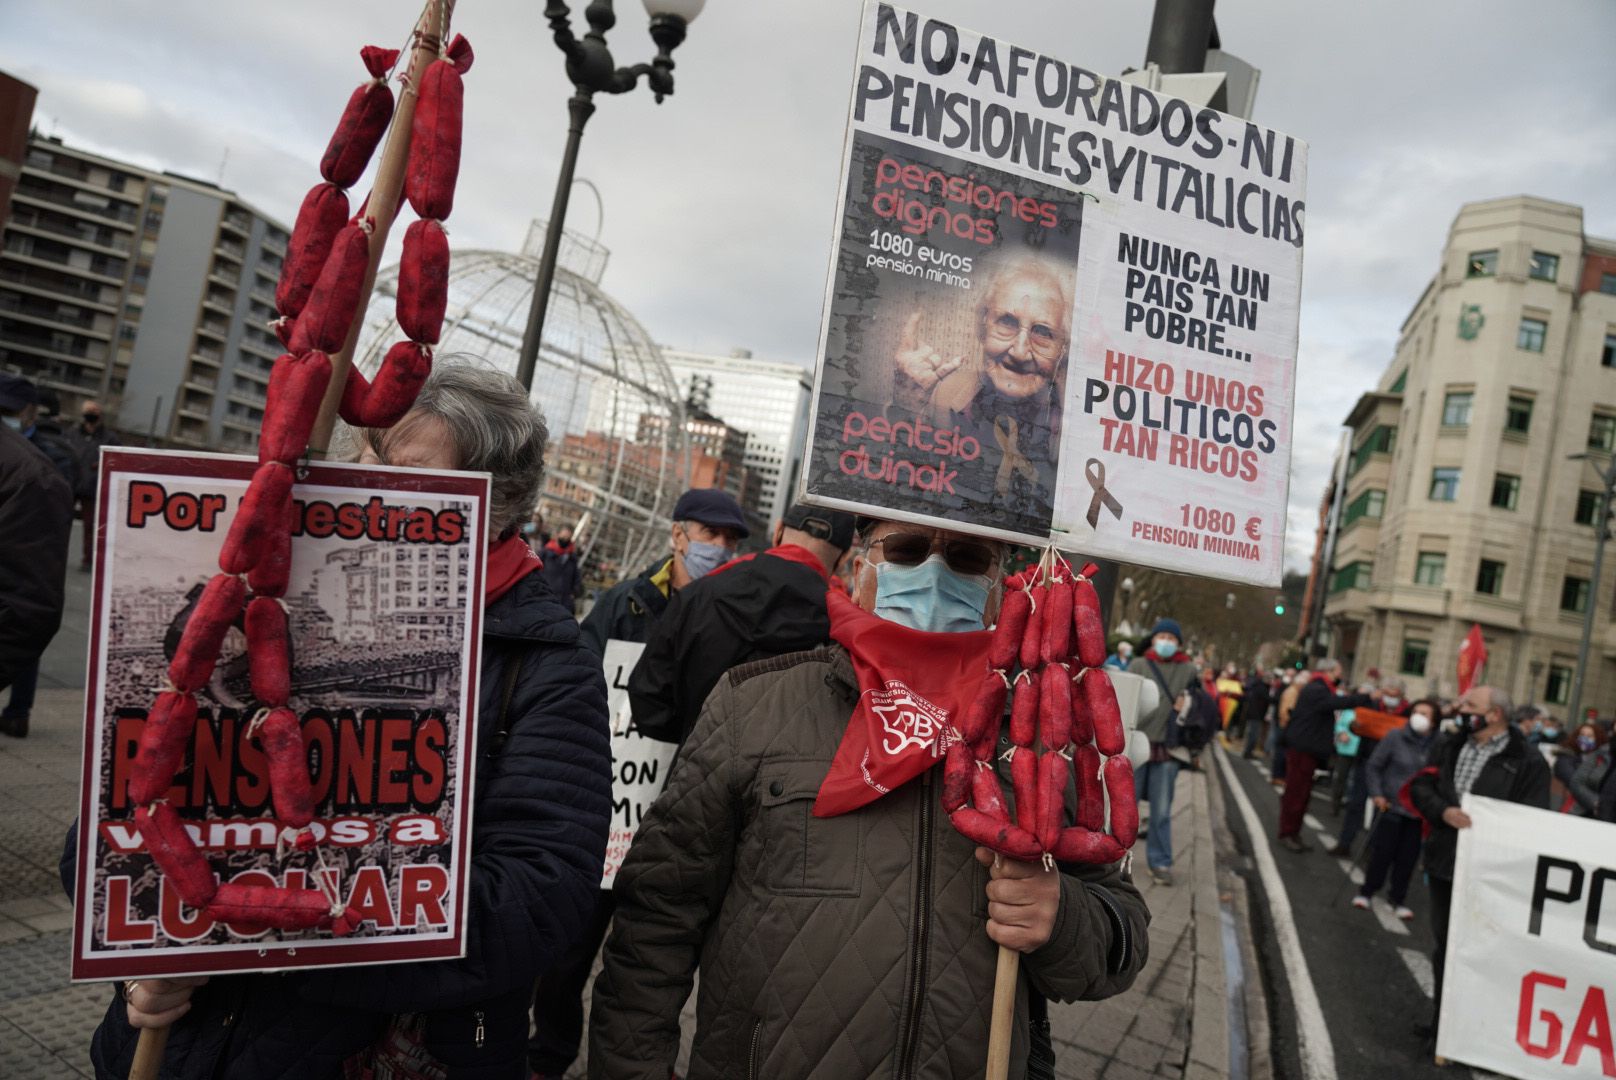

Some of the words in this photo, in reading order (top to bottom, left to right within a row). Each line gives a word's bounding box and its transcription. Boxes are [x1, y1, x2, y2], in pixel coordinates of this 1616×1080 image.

[872, 189, 994, 245] dignas
[874, 159, 1058, 228] pensiones
[866, 253, 923, 278] pensión
[926, 270, 970, 289] mínima
[869, 229, 914, 258] 1080
[917, 245, 972, 273] euros
[1117, 232, 1221, 289] NUNCA
[1230, 264, 1270, 302] UN
[1125, 267, 1194, 314] PAIS
[1203, 288, 1258, 331] TAN
[1125, 301, 1251, 363] POBRE...
[1104, 350, 1174, 395] HIZO
[1184, 369, 1265, 417] UNOS
[842, 411, 981, 461] pentsio
[1084, 377, 1277, 454] POLITICOS
[838, 444, 958, 496] duinak
[1099, 417, 1159, 461] TAN
[1168, 434, 1259, 482] RICOS
[127, 480, 225, 532] Por
[240, 492, 464, 545] estras
[1180, 503, 1235, 536] 1080
[1244, 516, 1262, 542] €
[1131, 521, 1199, 549] PENSION
[1203, 535, 1261, 561] MINIMA
[111, 706, 448, 815] PNSONES
[611, 758, 658, 785] ON
[387, 813, 446, 846] a
